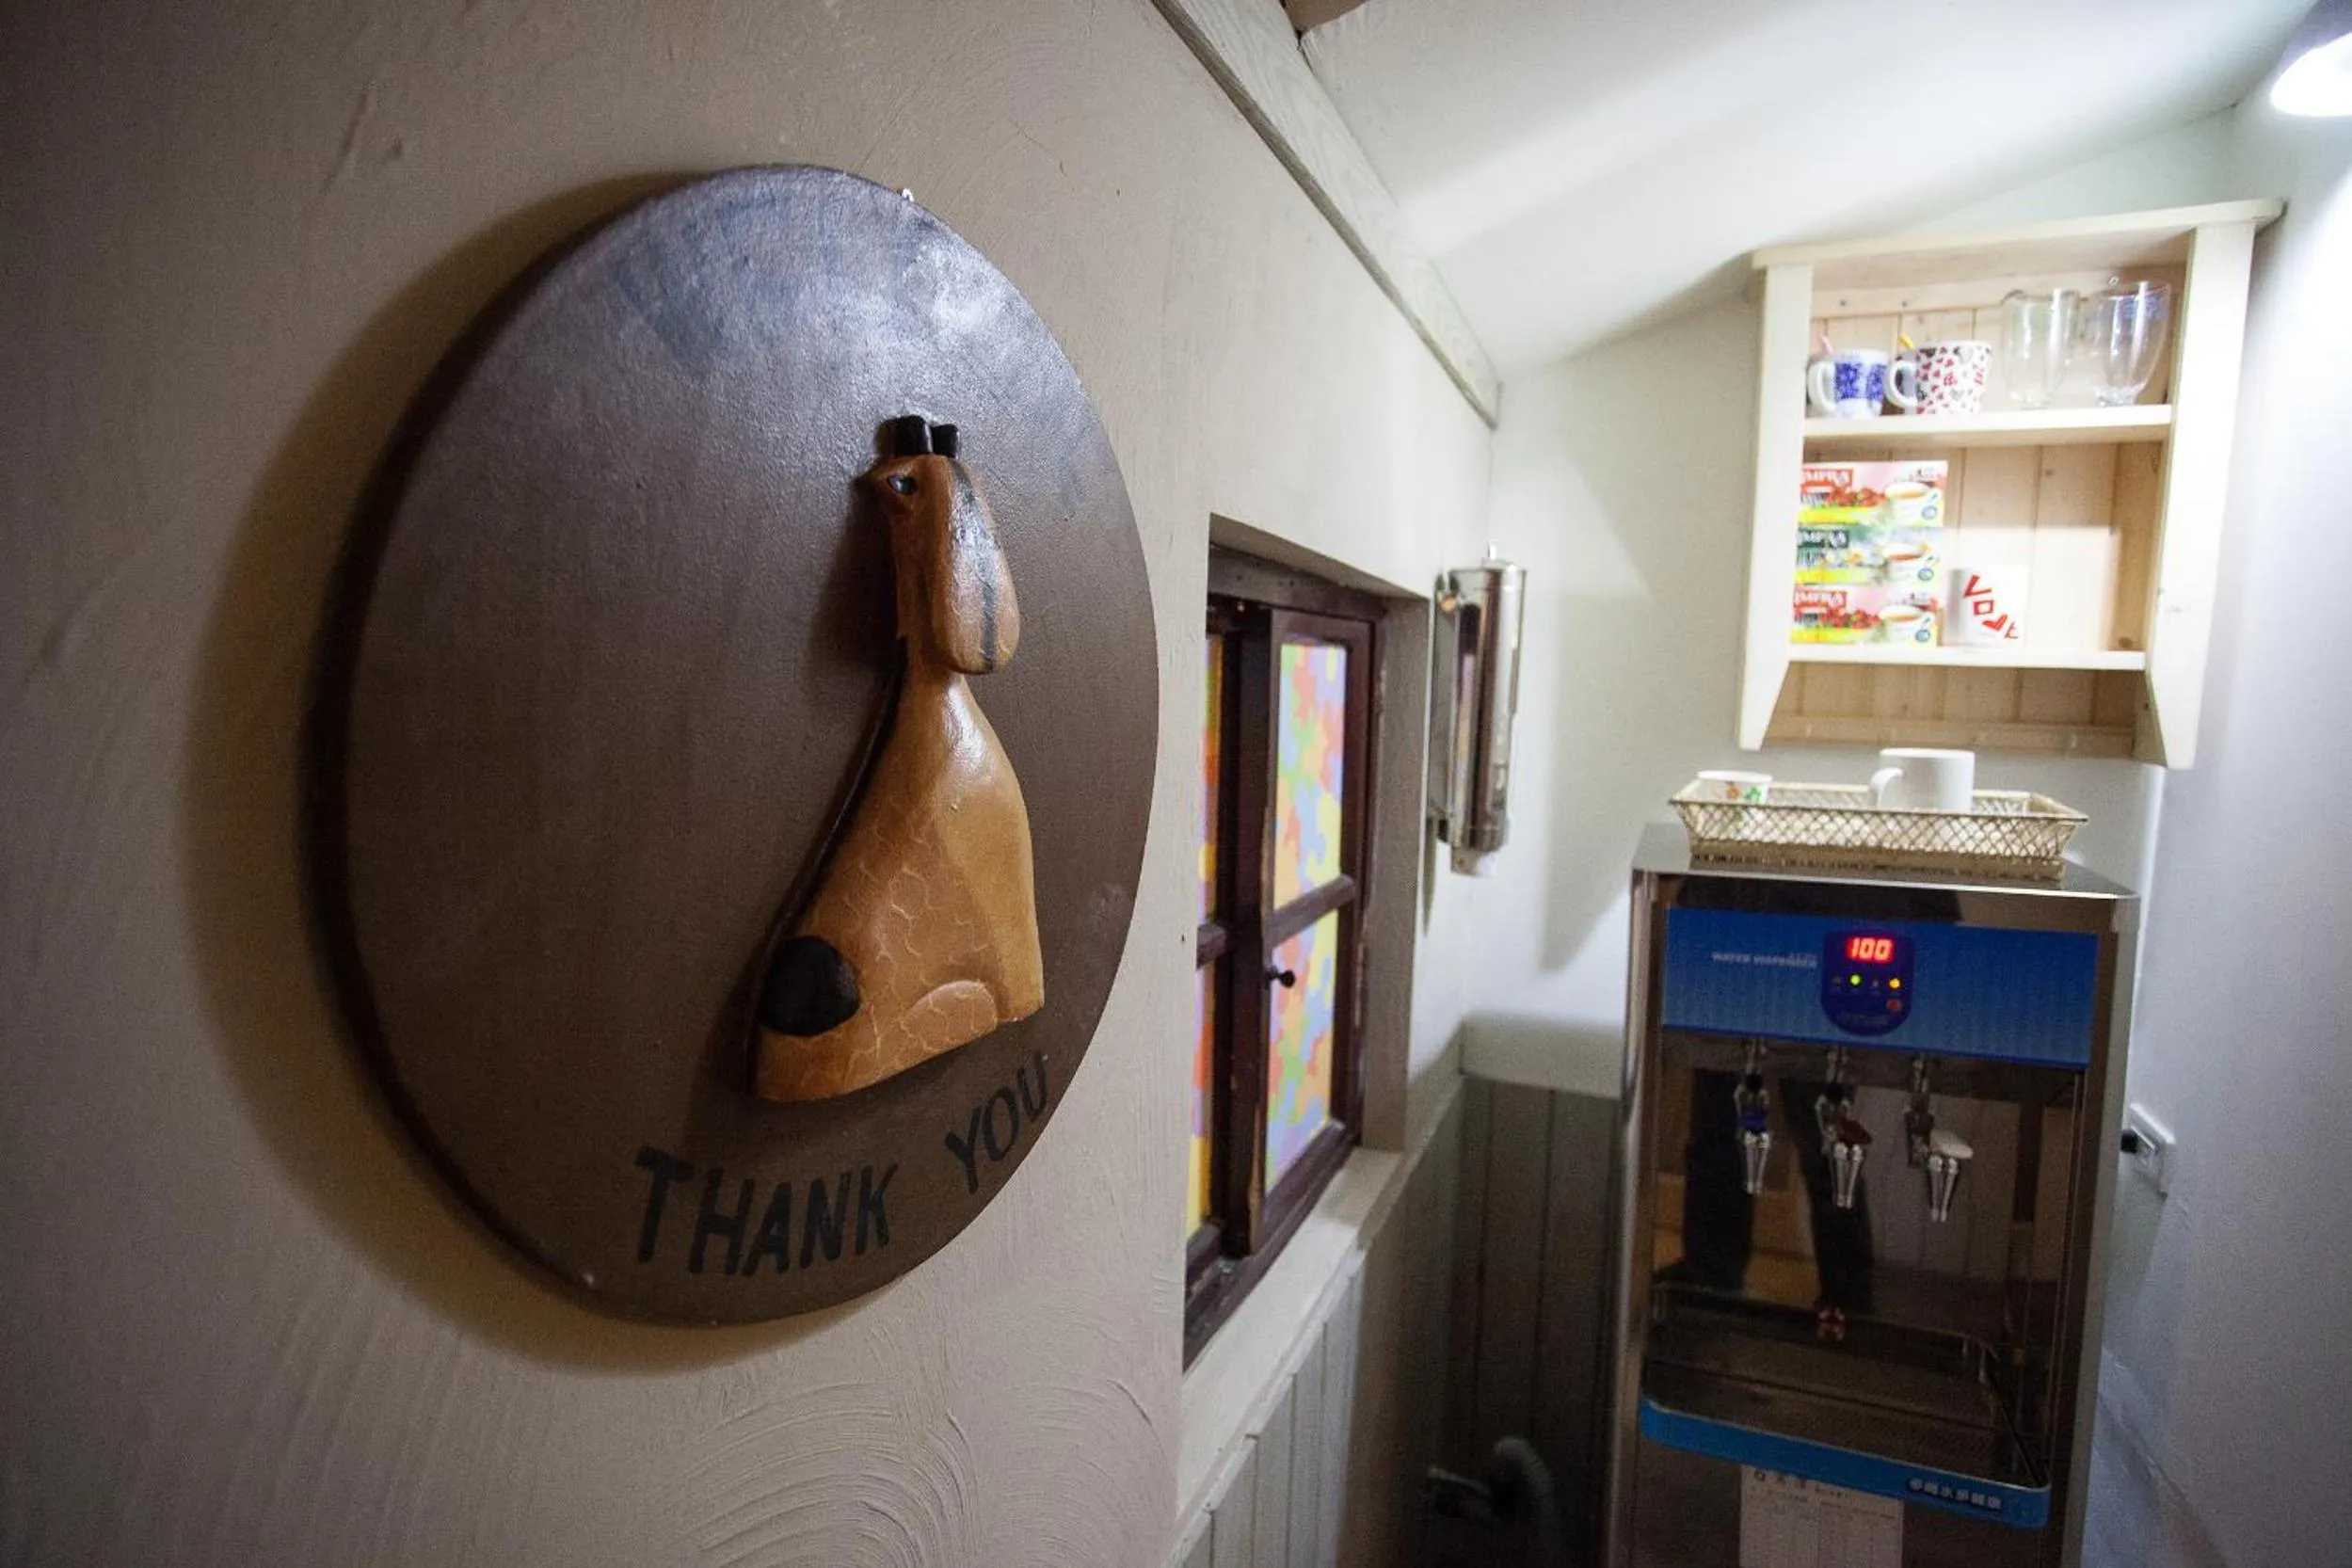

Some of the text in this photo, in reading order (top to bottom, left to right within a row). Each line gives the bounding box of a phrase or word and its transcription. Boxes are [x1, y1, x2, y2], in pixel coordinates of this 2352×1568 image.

[1850, 936, 1893, 963] 100
[633, 1050, 1050, 1277] THANK YOU
